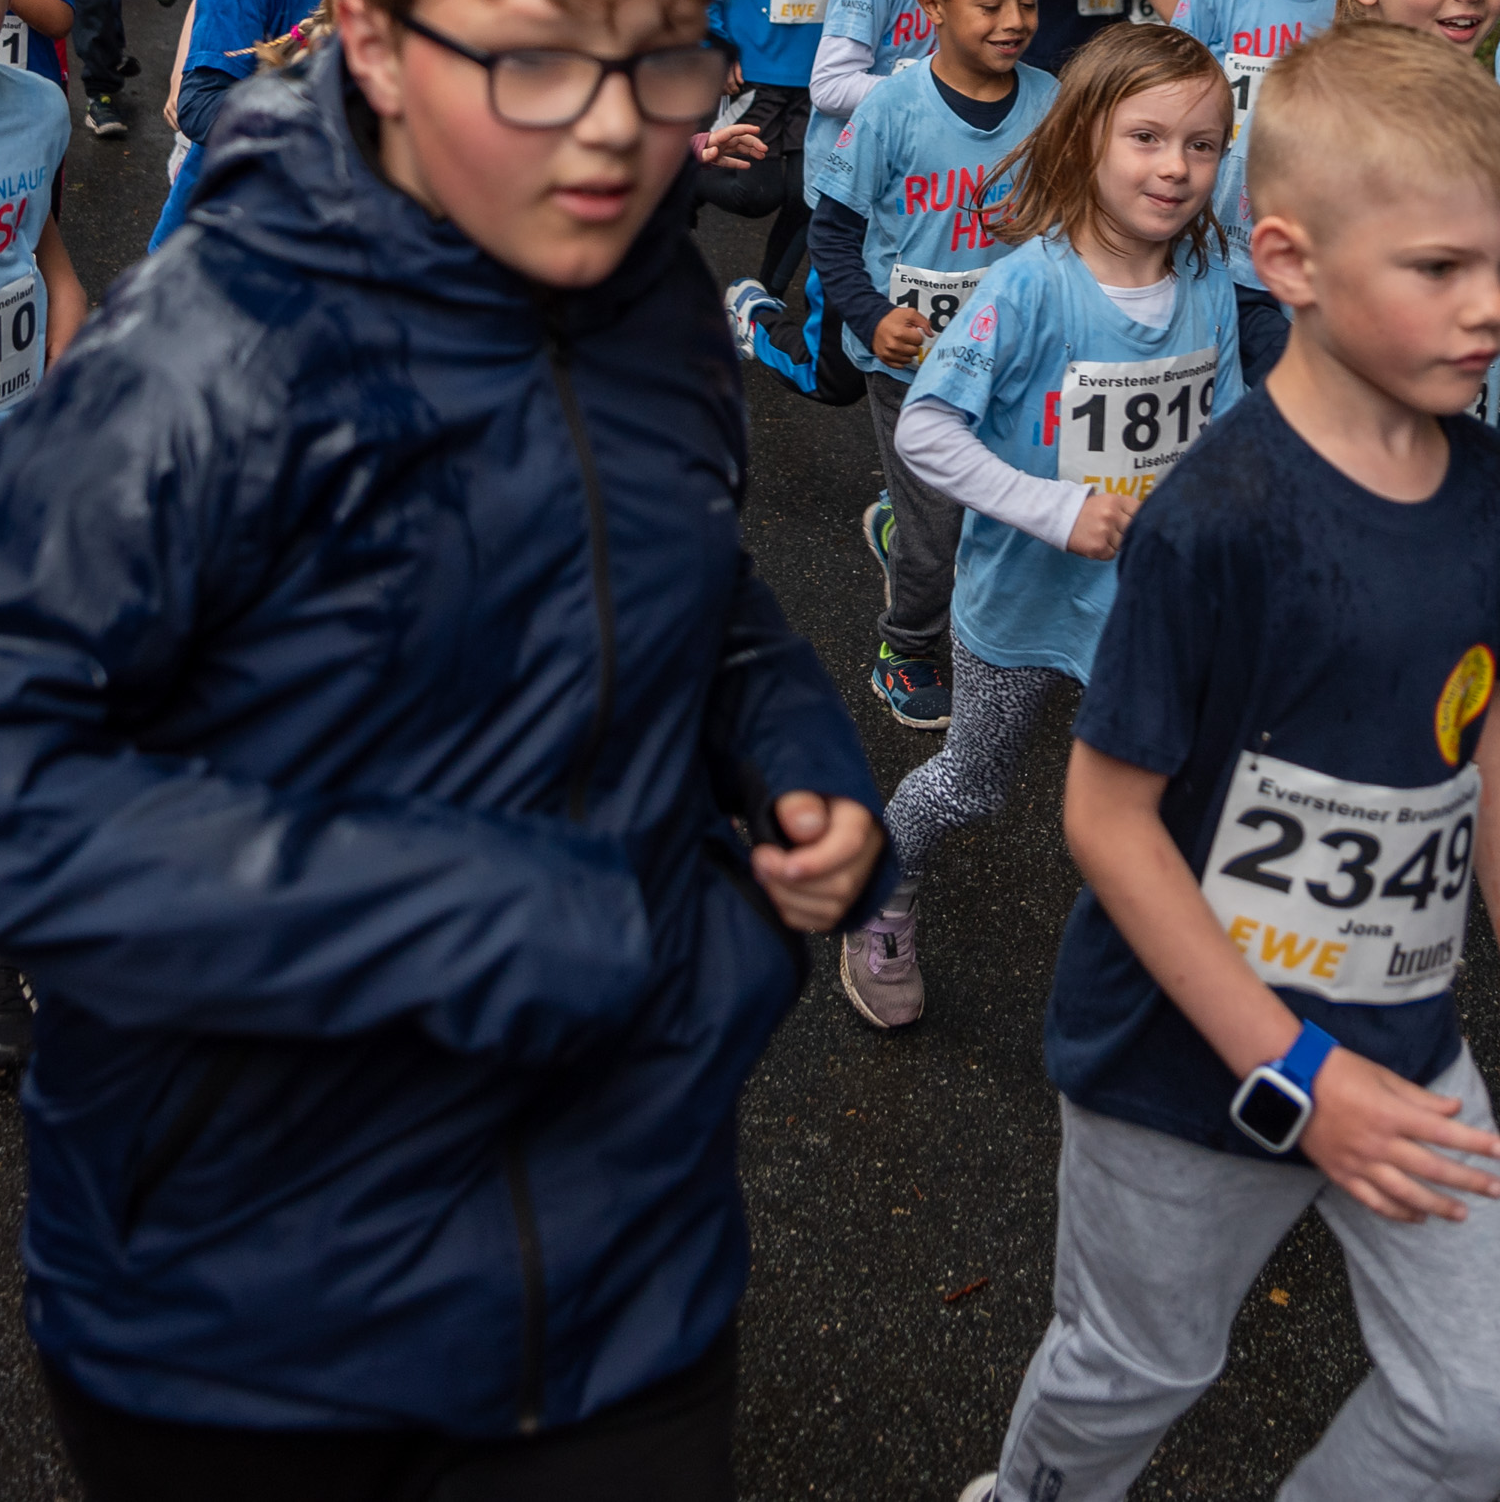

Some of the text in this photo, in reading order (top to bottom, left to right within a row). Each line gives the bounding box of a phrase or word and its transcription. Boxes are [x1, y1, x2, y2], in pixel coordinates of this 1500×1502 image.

[781, 3, 816, 17] EWE
[900, 275, 959, 290] Everstener
[1079, 374, 1160, 387] Everstener
[1258, 777, 1389, 823] Everstener
[1219, 806, 1473, 911] 2349
[1338, 919, 1394, 938] Jona
[1228, 915, 1453, 979] EWE bruns
